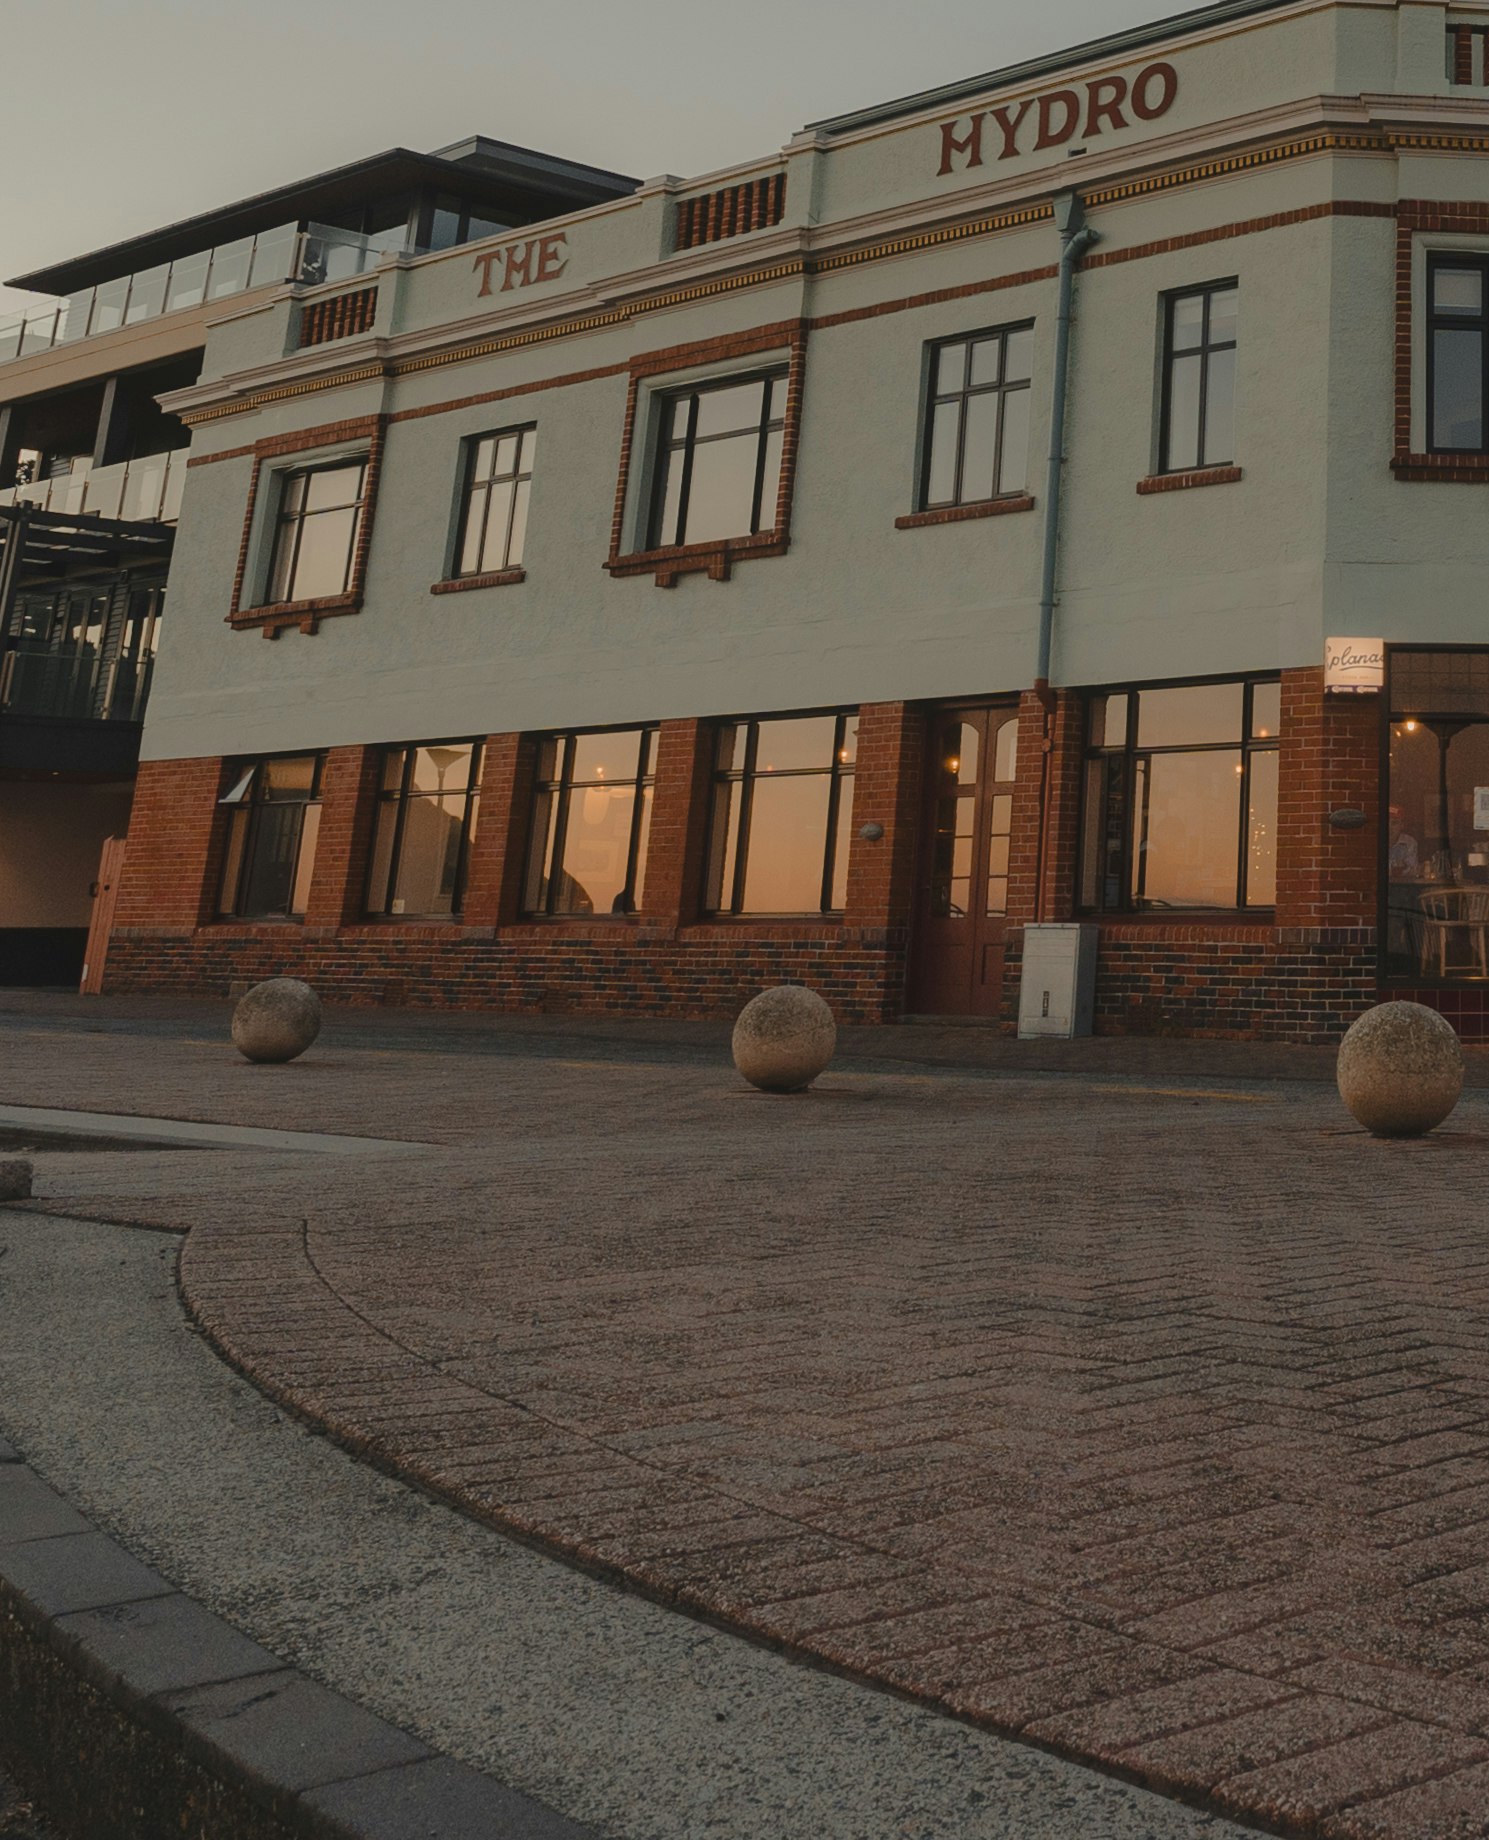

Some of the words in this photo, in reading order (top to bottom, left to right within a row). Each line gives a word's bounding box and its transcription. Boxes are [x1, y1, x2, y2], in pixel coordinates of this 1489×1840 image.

[936, 62, 1178, 176] HYDRO
[472, 232, 569, 298] THE
[1327, 645, 1385, 672] plana
